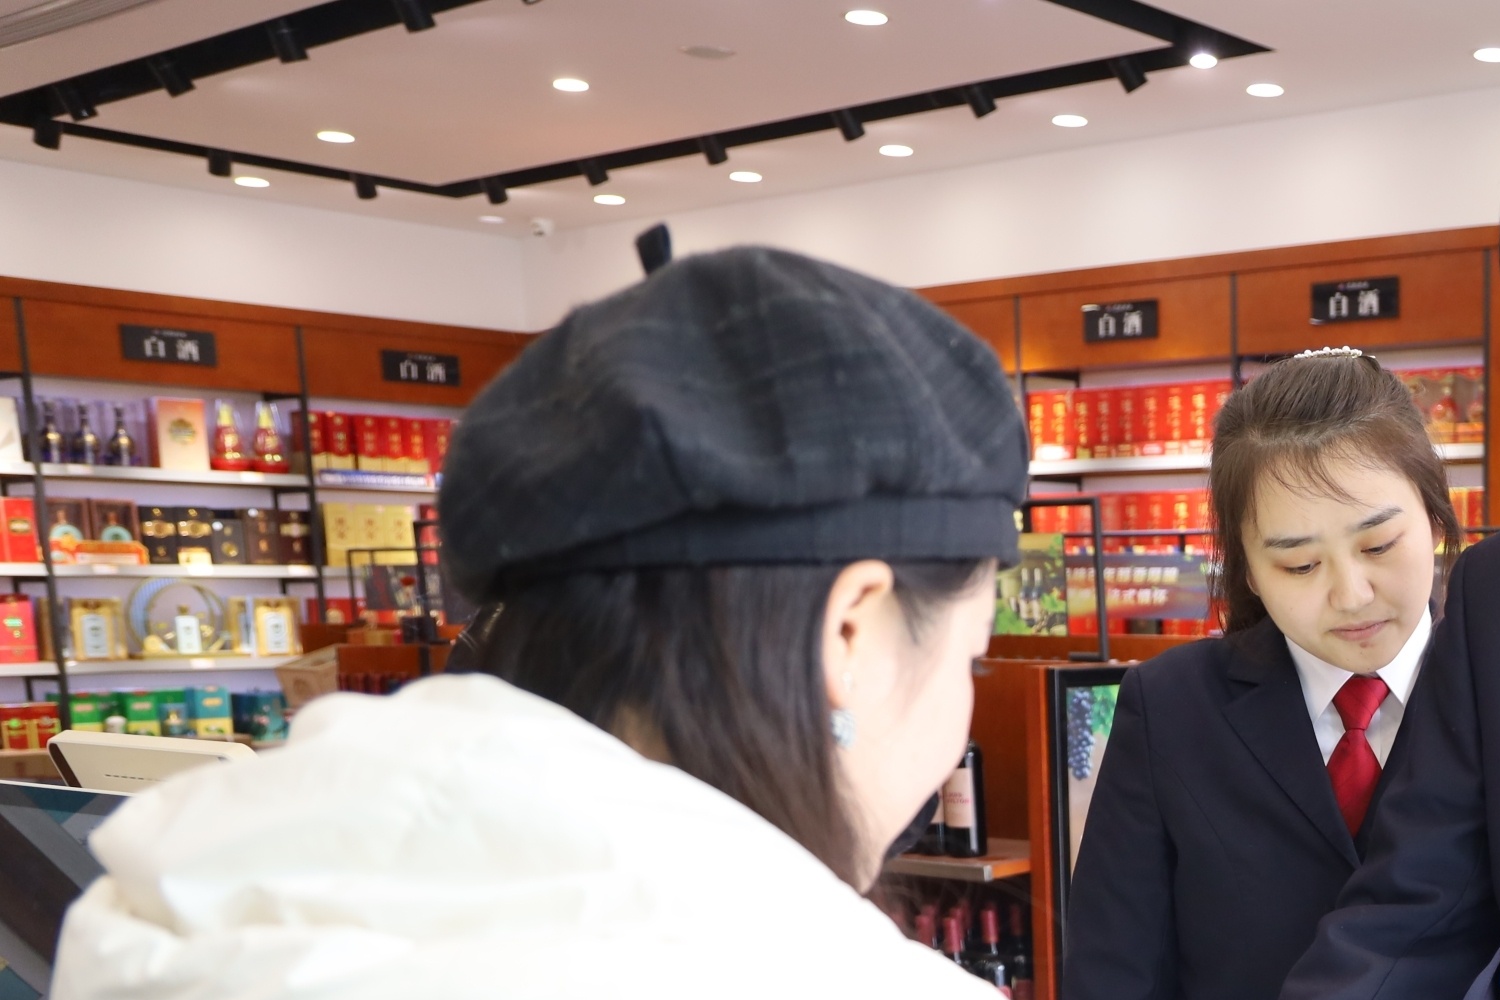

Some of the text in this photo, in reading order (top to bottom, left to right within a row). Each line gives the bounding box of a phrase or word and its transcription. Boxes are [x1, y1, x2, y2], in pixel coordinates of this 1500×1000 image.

[1328, 288, 1380, 318] 白酒
[1098, 310, 1143, 339] 白酒
[143, 336, 201, 363] 白酒
[399, 359, 447, 383] 白酒
